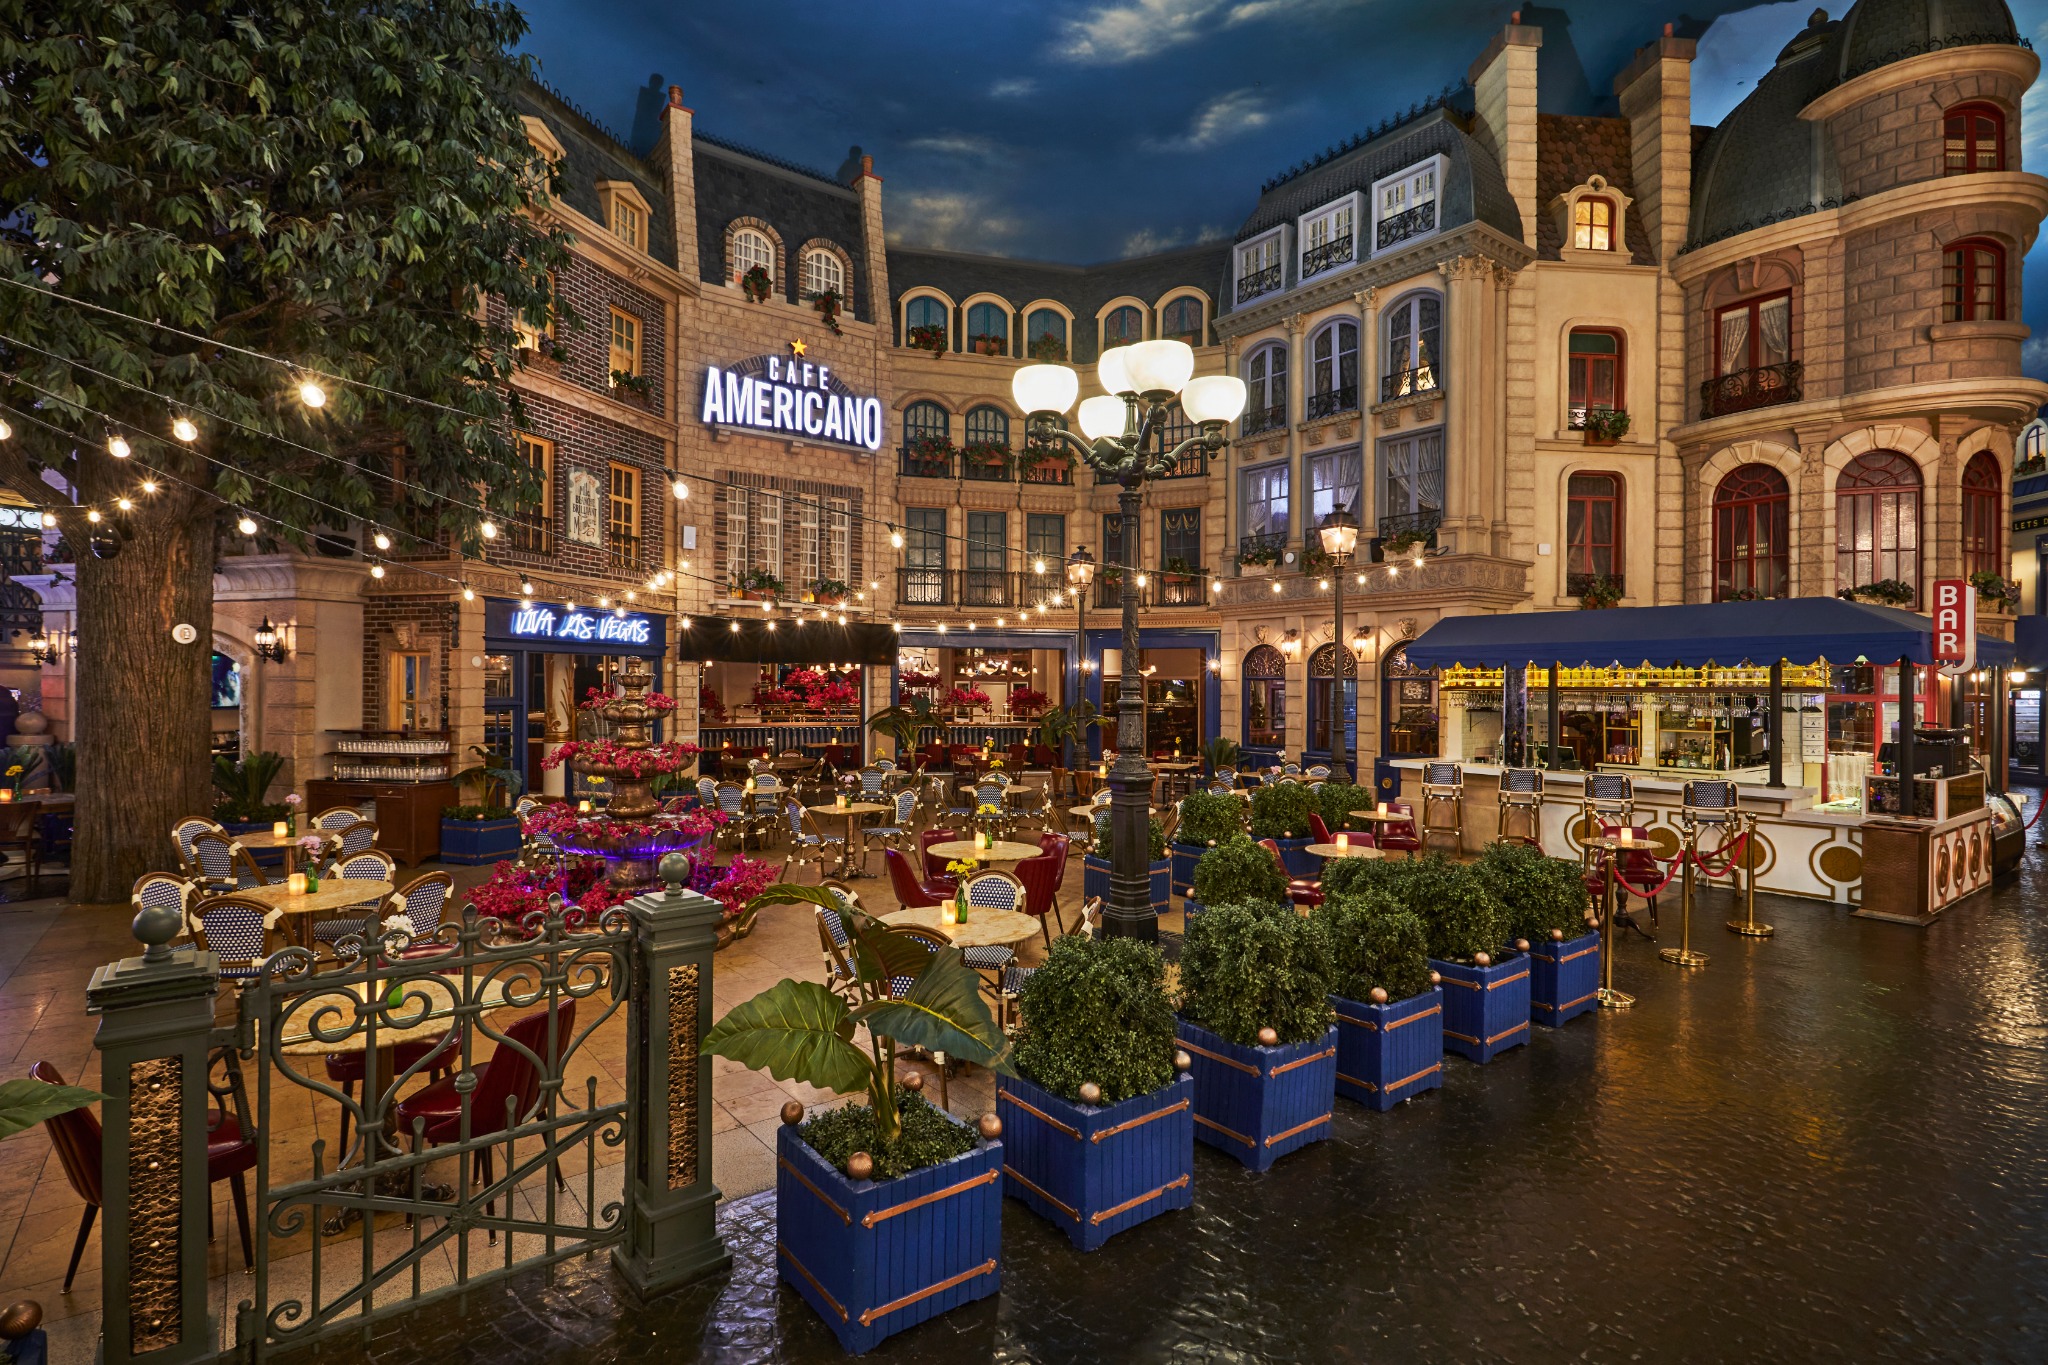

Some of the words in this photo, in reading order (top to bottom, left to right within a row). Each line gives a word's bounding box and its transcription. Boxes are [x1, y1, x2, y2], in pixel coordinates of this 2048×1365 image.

[769, 356, 829, 390] CAFE
[702, 366, 882, 450] AMERICANO
[514, 608, 556, 636] VIVA
[559, 613, 595, 640] LAS
[599, 615, 650, 643] VEGAS
[1939, 585, 1958, 654] BAR
